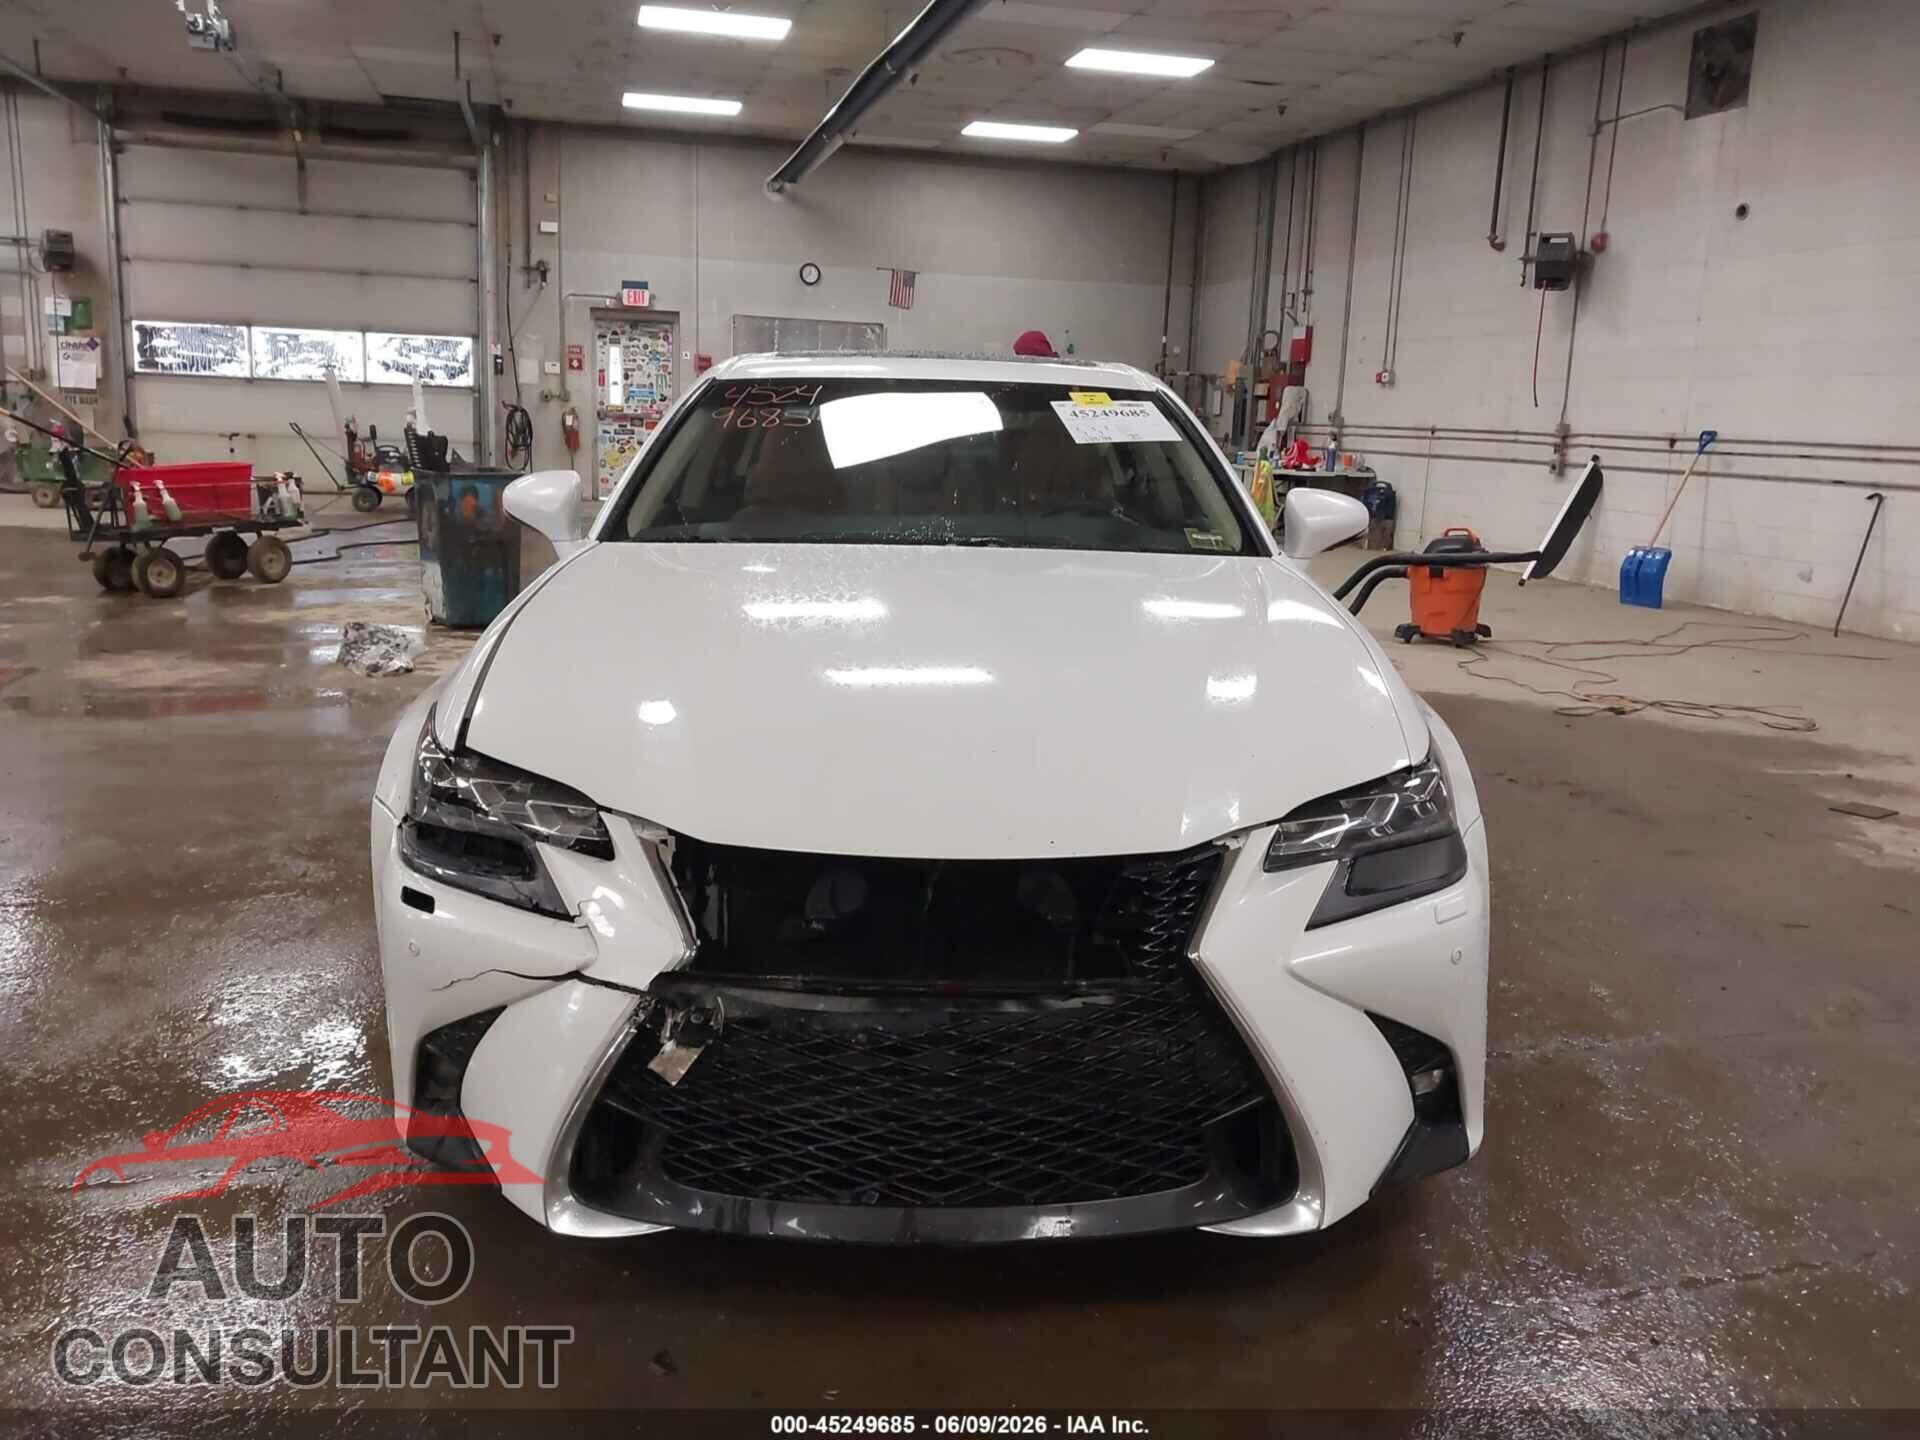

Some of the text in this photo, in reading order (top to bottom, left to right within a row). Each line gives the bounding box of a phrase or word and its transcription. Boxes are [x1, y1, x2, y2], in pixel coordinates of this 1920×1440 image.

[627, 289, 645, 304] EXIT
[724, 384, 823, 408] 4524
[712, 407, 812, 429] 9685
[1069, 409, 1151, 418] 45249685
